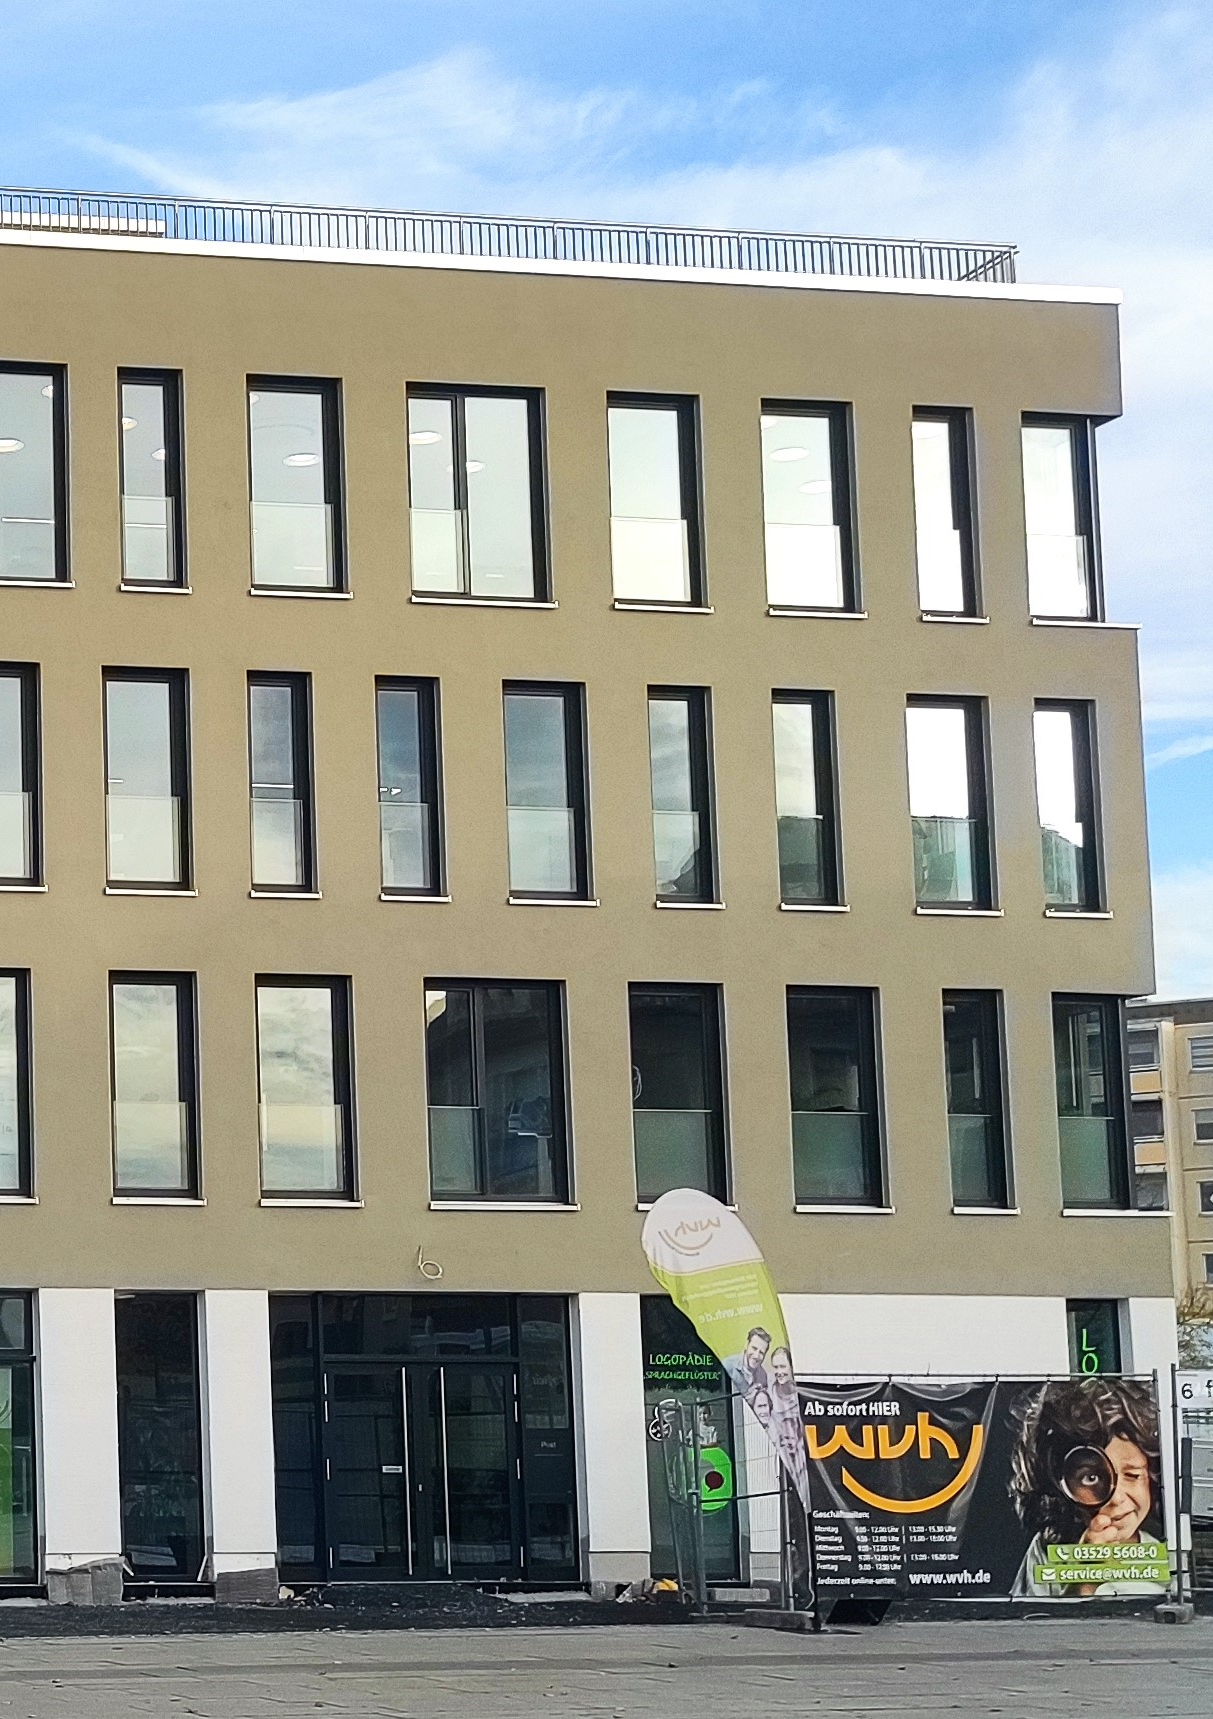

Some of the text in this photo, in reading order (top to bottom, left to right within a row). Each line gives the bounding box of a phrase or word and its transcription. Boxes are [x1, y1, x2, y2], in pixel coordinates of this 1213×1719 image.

[649, 1351, 714, 1366] LOGOPÄDIE
[1181, 1383, 1193, 1399] 6
[804, 1401, 901, 1416] Ab sofort HIER
[804, 1411, 960, 1459] wvh
[1073, 1545, 1158, 1559] 03529 5608-0
[908, 1569, 991, 1585] www.wvh.de
[1059, 1565, 1160, 1580] service@wvh.de
